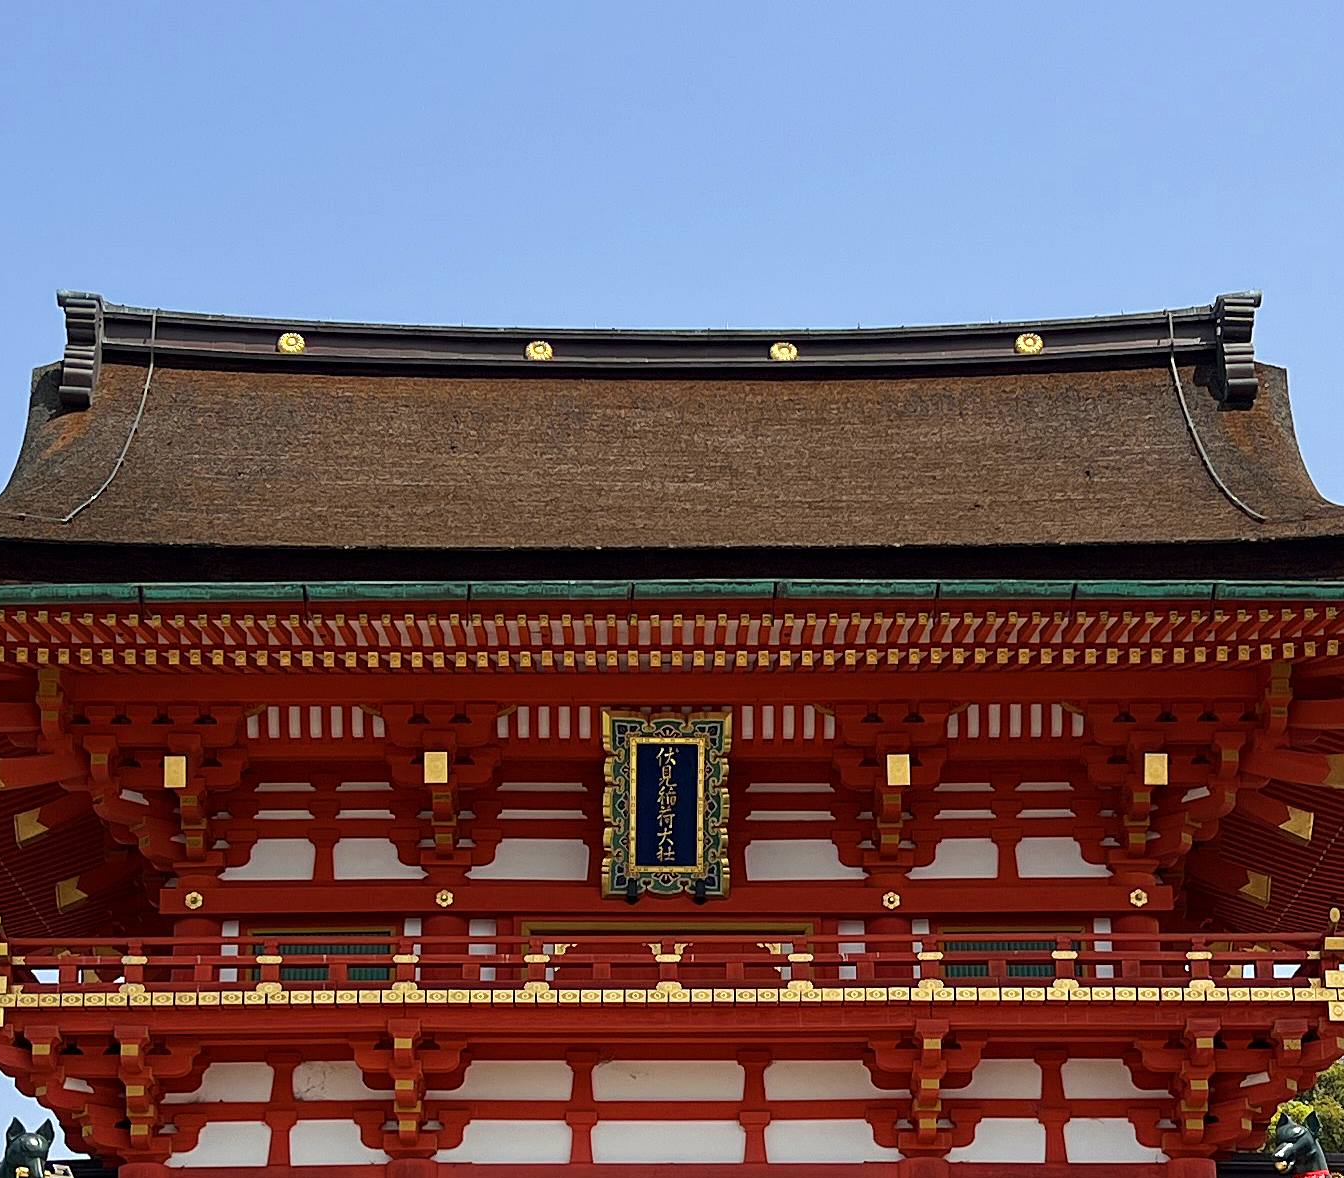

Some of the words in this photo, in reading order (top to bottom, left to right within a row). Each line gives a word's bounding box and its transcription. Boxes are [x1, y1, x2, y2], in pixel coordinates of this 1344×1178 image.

[656, 746, 680, 862] 伏見稲荷大社
